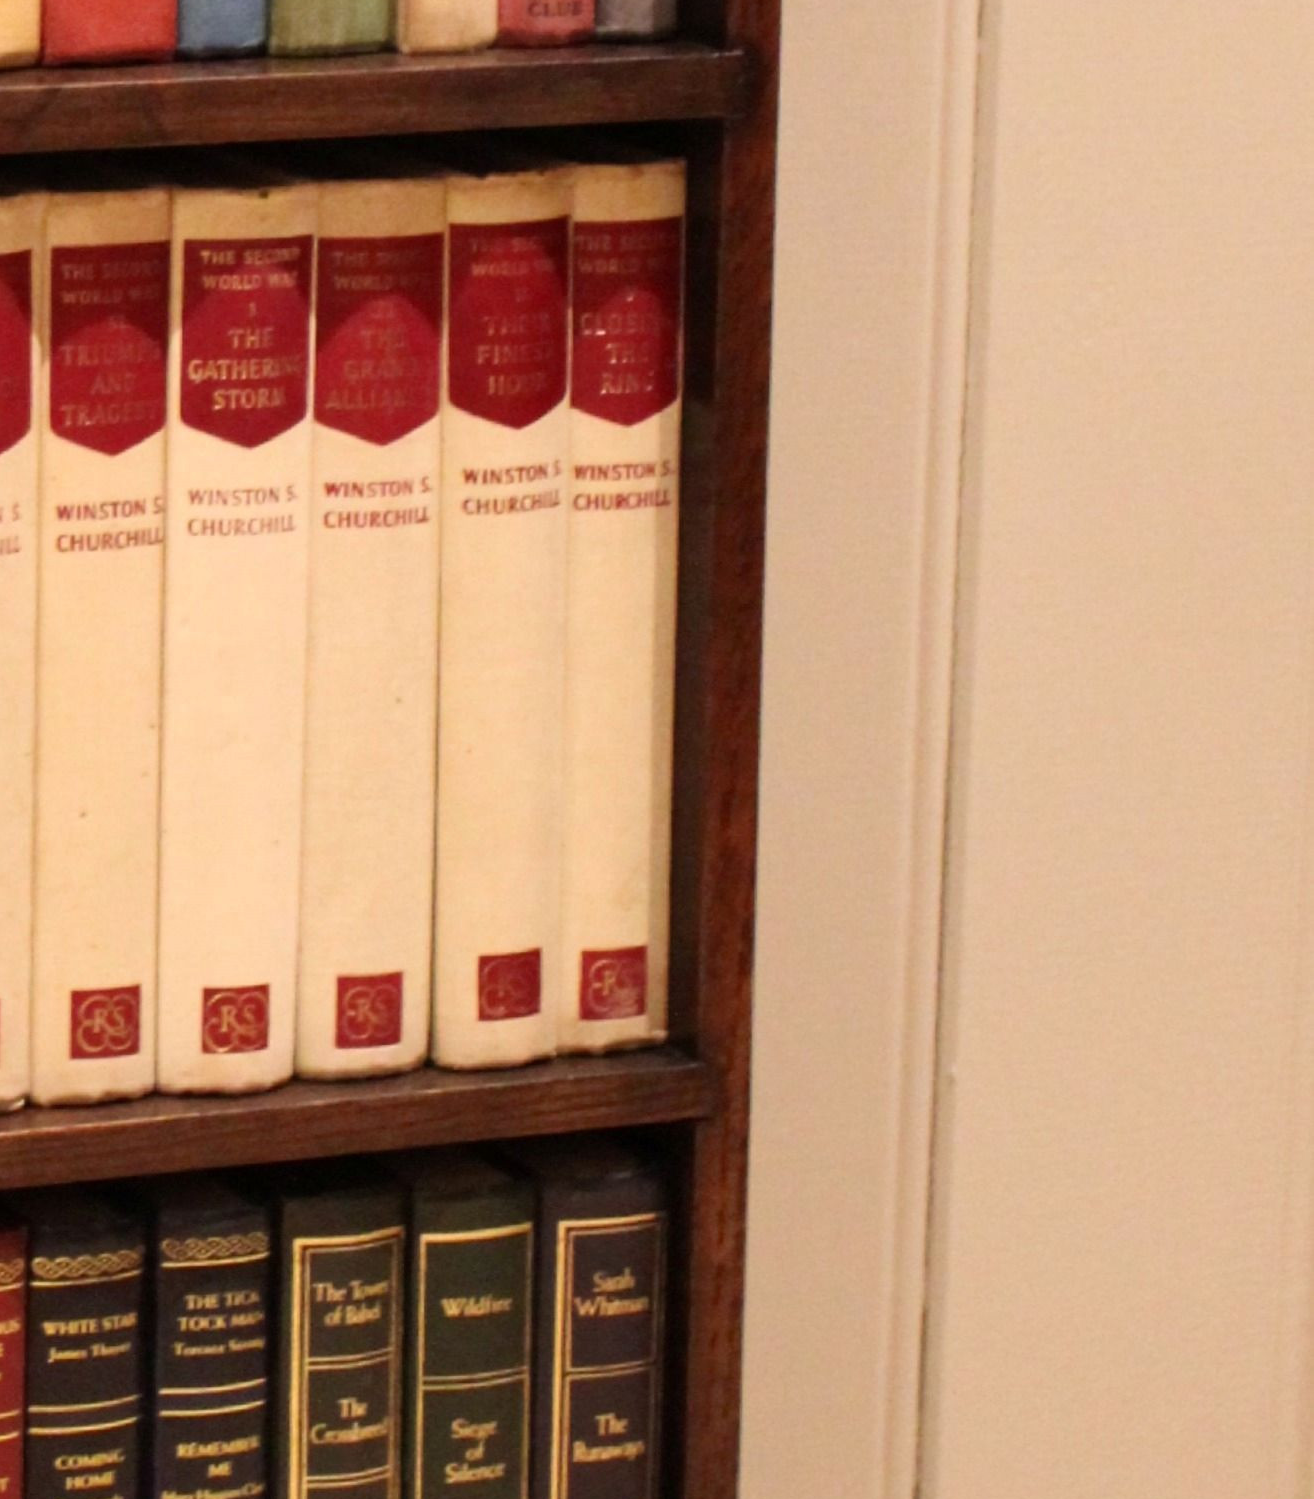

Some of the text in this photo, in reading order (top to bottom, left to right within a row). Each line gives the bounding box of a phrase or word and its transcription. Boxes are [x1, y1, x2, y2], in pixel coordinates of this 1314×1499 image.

[527, 1, 584, 18] CLUB
[200, 250, 236, 265] THE
[202, 274, 262, 291] WORLD
[229, 327, 275, 348] THE
[462, 463, 548, 485] WINSTON
[574, 463, 656, 481] WINSTON
[188, 487, 281, 507] WINSTON
[324, 480, 413, 498] WINSTON
[56, 498, 146, 522] WINSTON
[462, 490, 560, 516] CHURCHILL
[573, 490, 671, 512] CHURCHILL
[187, 514, 296, 537] CHURCHILL
[323, 507, 430, 529] CHURCHILL
[56, 527, 165, 553] CHURCHILL
[185, 1293, 220, 1311] THE
[313, 1282, 348, 1303] The
[42, 1317, 99, 1336] WHITE
[177, 1314, 227, 1332] TOCK
[324, 1307, 343, 1327] of
[337, 1397, 368, 1418] The
[595, 1412, 629, 1436] The
[465, 1441, 485, 1462] of
[65, 1470, 116, 1490] HOME
